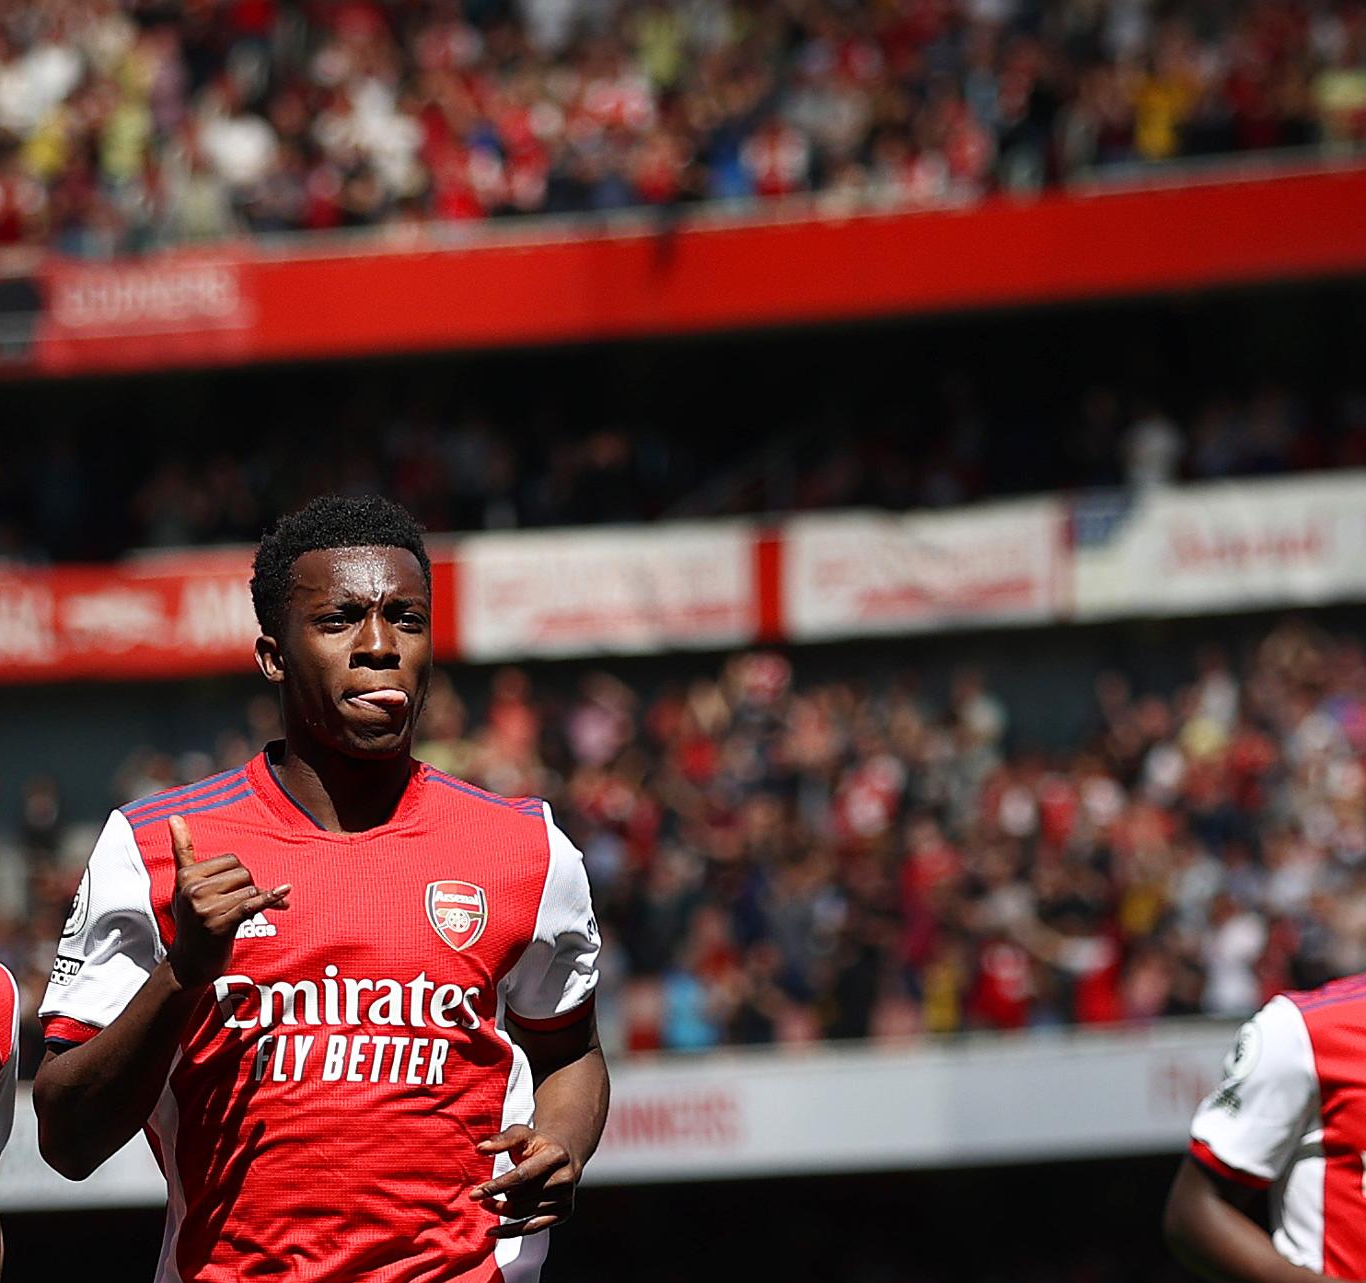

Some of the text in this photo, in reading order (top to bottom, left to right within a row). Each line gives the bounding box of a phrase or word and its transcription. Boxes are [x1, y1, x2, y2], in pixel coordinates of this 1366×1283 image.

[214, 964, 480, 1030] Emirates
[254, 1035, 448, 1085] FLY BETTER
